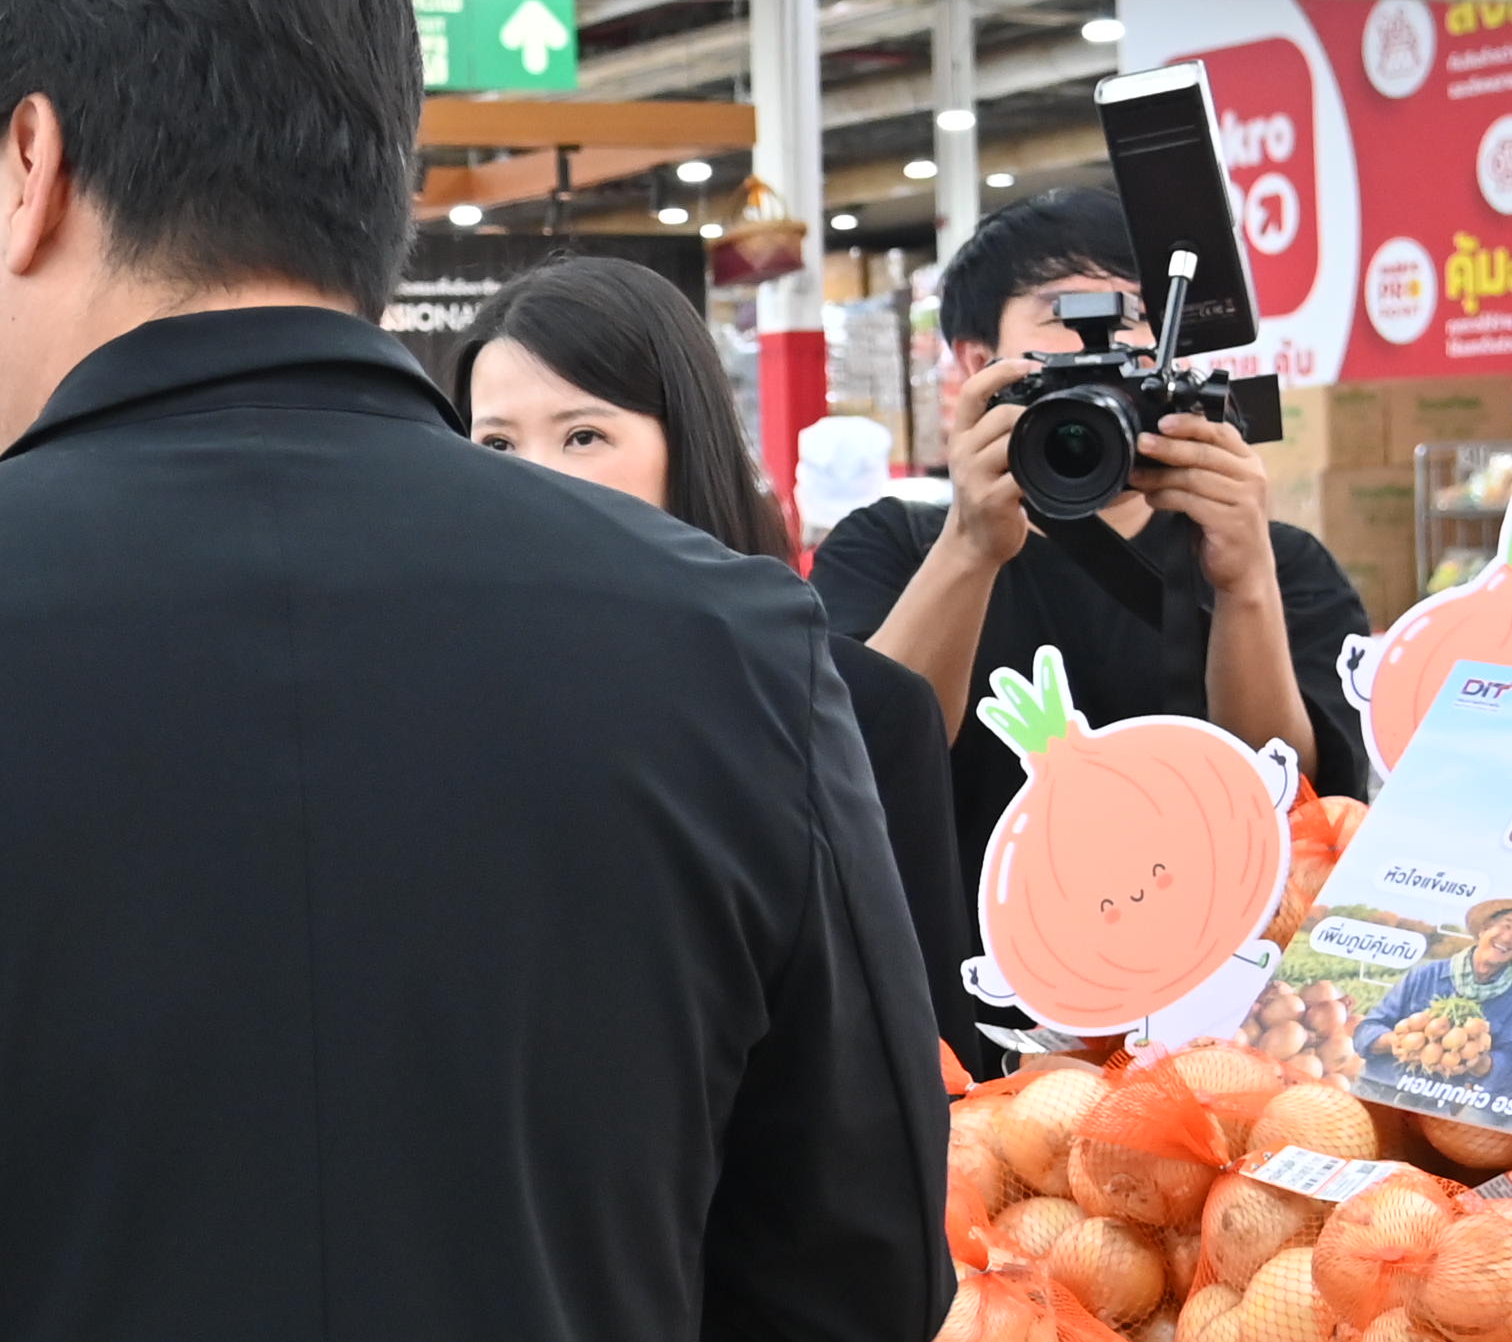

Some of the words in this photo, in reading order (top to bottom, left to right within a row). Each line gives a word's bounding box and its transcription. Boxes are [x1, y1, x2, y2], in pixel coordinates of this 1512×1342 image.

[1382, 865, 1477, 900] หัวใจแข็งแรง
[1316, 920, 1419, 965] เพิ่มภูมิคุ้มกัน
[1396, 1070, 1491, 1114] หอมทุกหัว
